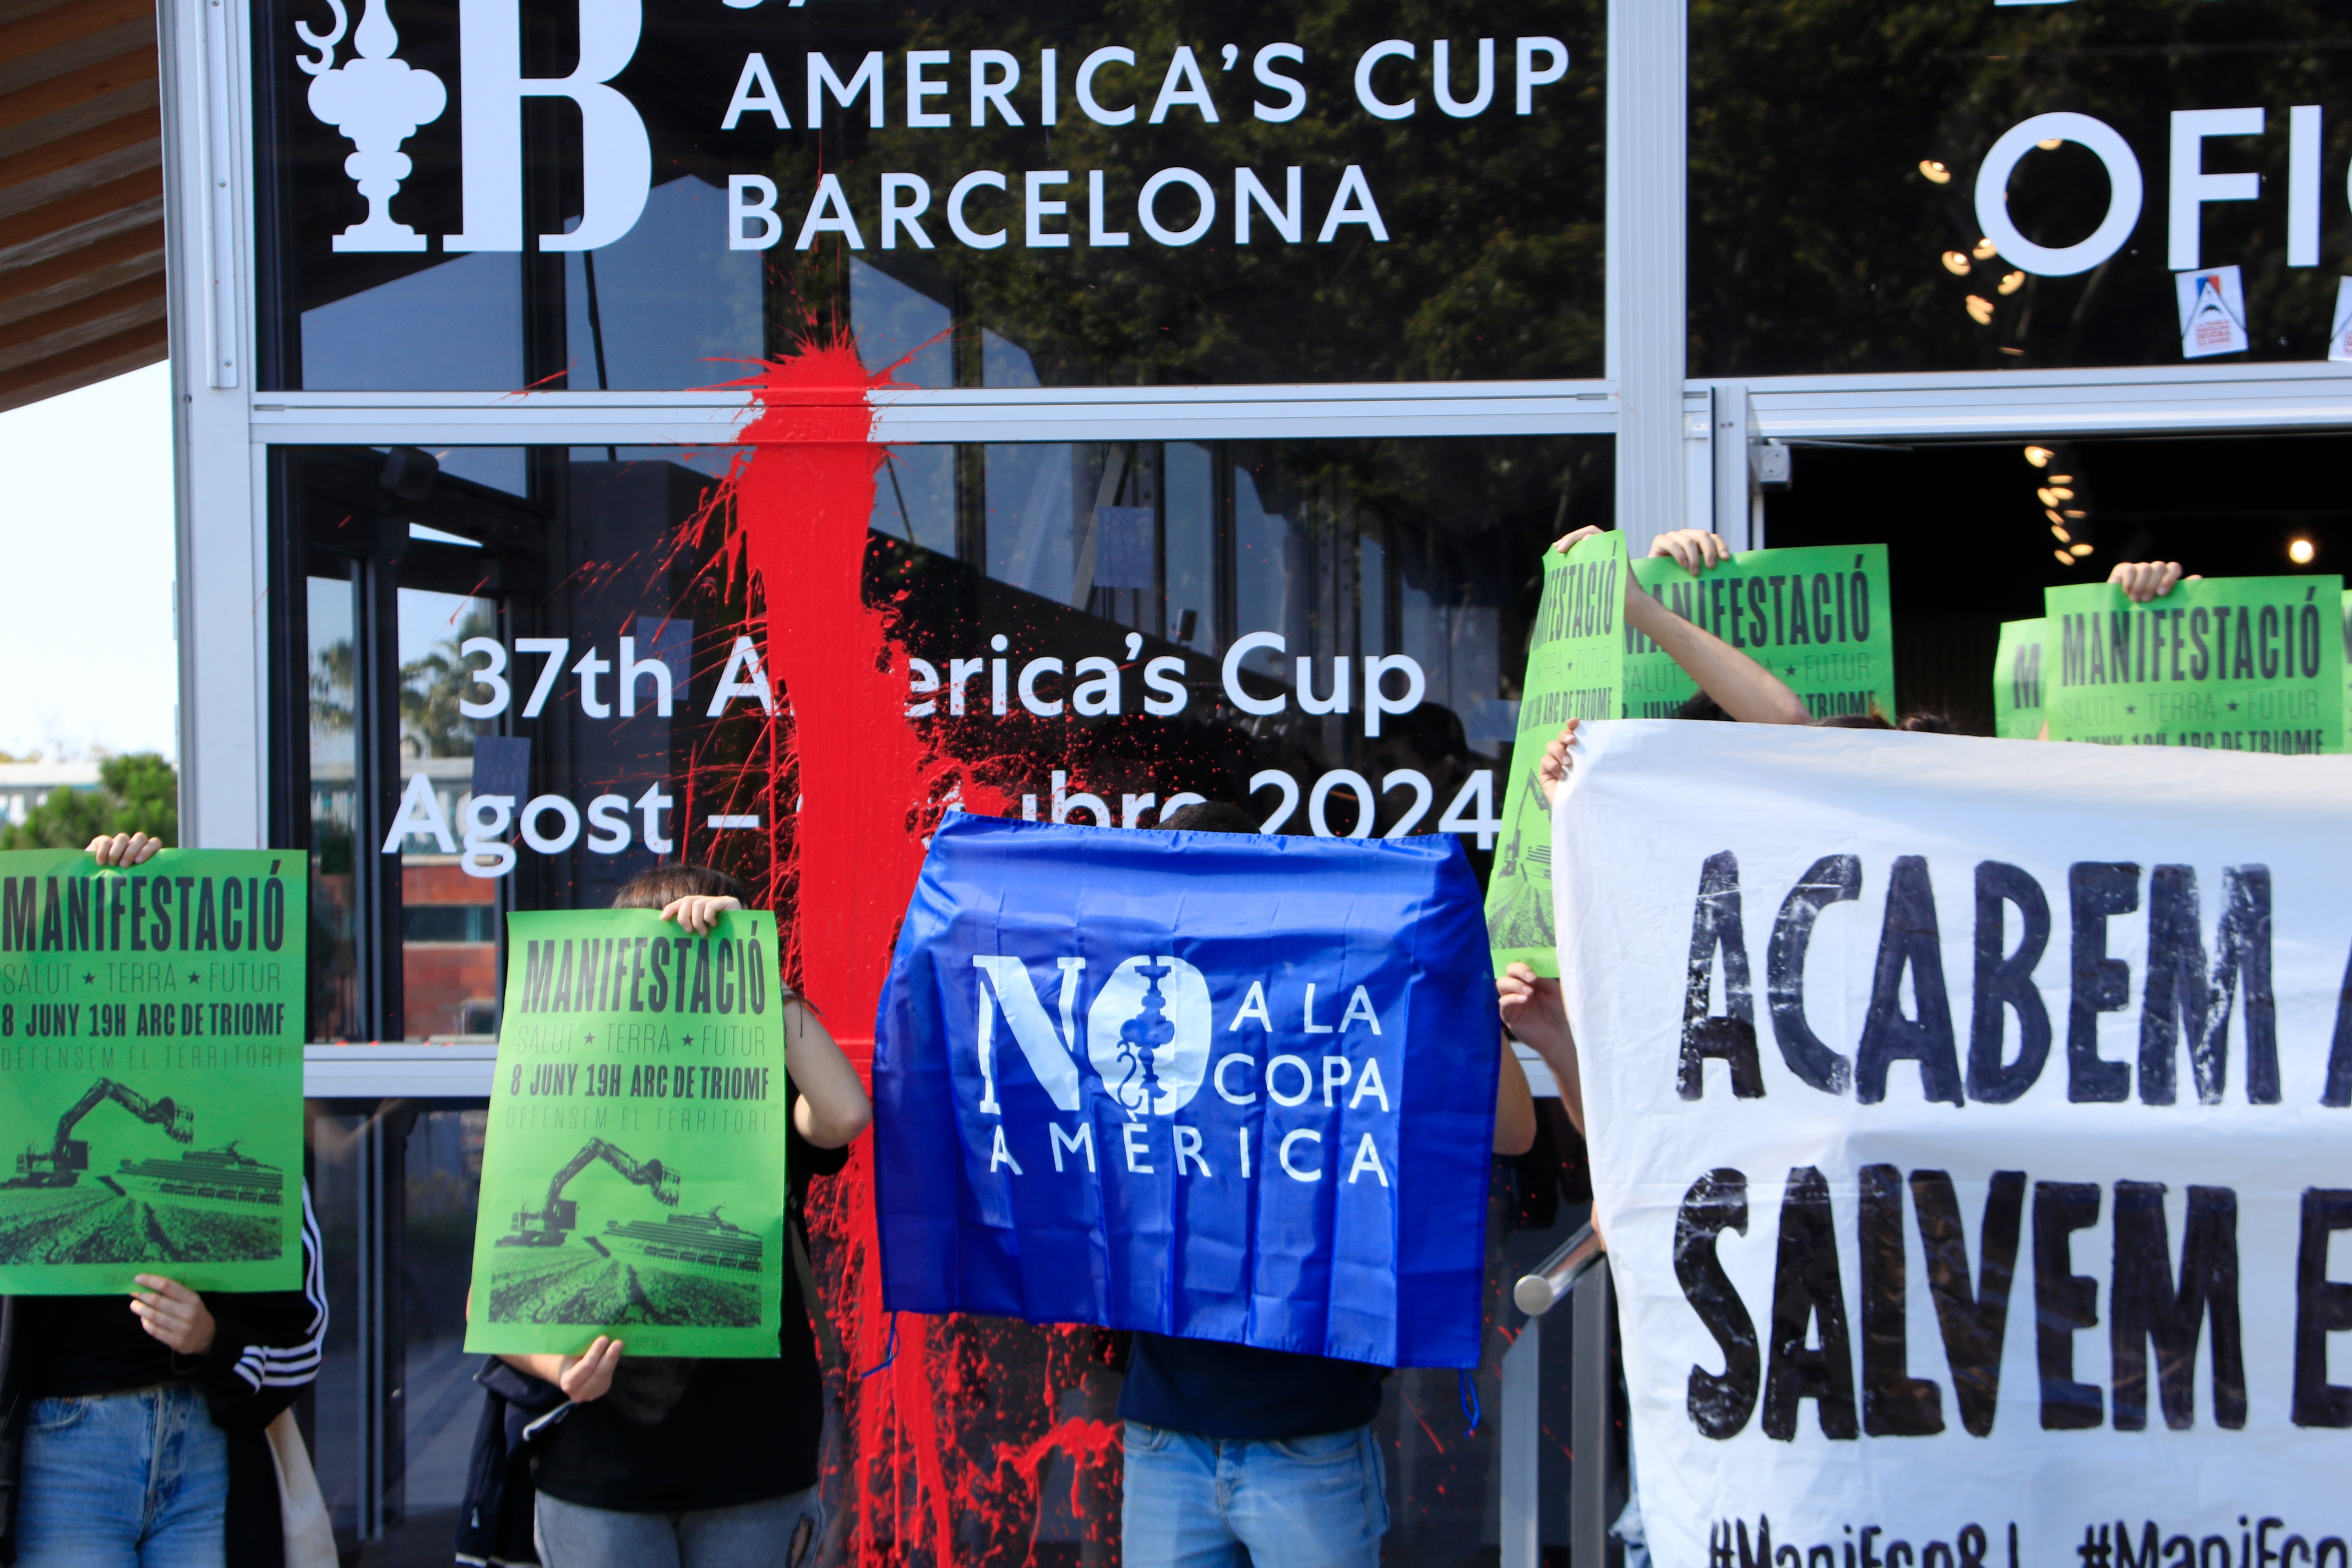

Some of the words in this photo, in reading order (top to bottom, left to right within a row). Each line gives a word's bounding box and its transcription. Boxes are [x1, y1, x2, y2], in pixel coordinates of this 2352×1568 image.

[721, 42, 1306, 129] AMERICA'S
[1354, 36, 1569, 120] CUP
[728, 165, 1389, 251] BARCELONA
[1974, 105, 2352, 277] OFI
[1804, 652, 1870, 683] FUTUR
[2061, 585, 2320, 687] MANIFESTACIÓ
[459, 636, 672, 719] 37th
[1222, 631, 1426, 737] Cup
[2061, 696, 2116, 727] SALUT
[2147, 693, 2216, 723] TERRA
[2247, 689, 2319, 720] FUTUR
[381, 772, 673, 878] Agost
[1249, 768, 1501, 850] 2024
[2, 859, 285, 952] MANIFESTACIÓ
[2, 962, 72, 994] SALUT
[107, 962, 177, 993] TERRA
[209, 962, 281, 993] FUTUR
[520, 920, 766, 1015] MANIFESTACIÓ
[1229, 981, 1272, 1032] A
[1303, 982, 1382, 1036] LA
[1676, 849, 2282, 1108] ACABEM
[2, 1003, 14, 1038] 8
[26, 1003, 80, 1037] JUNY
[89, 1003, 127, 1037] 19H
[136, 1003, 176, 1037] ARC
[181, 1003, 204, 1036] DE
[208, 1003, 285, 1036] TRIOMF
[2, 1046, 115, 1070] DEFENSEM
[129, 1045, 149, 1070] EL
[165, 1044, 284, 1069] TERRITORI
[516, 1023, 576, 1055] SALUT
[605, 1023, 670, 1054] TERRA
[702, 1025, 765, 1057] FUTUR
[972, 954, 1212, 1116] NO
[505, 1106, 607, 1130] DEFENSEM
[621, 1107, 639, 1131] EL
[656, 1108, 766, 1133] TERRITORI
[510, 1063, 522, 1096] 8
[529, 1063, 579, 1096] JUNY
[584, 1064, 622, 1097] 19H
[629, 1065, 668, 1098] ARC
[672, 1066, 695, 1099] DE
[700, 1066, 769, 1101] TRIOMF
[1213, 1053, 1389, 1113] COPA
[1673, 1163, 2248, 1441] SALVEM
